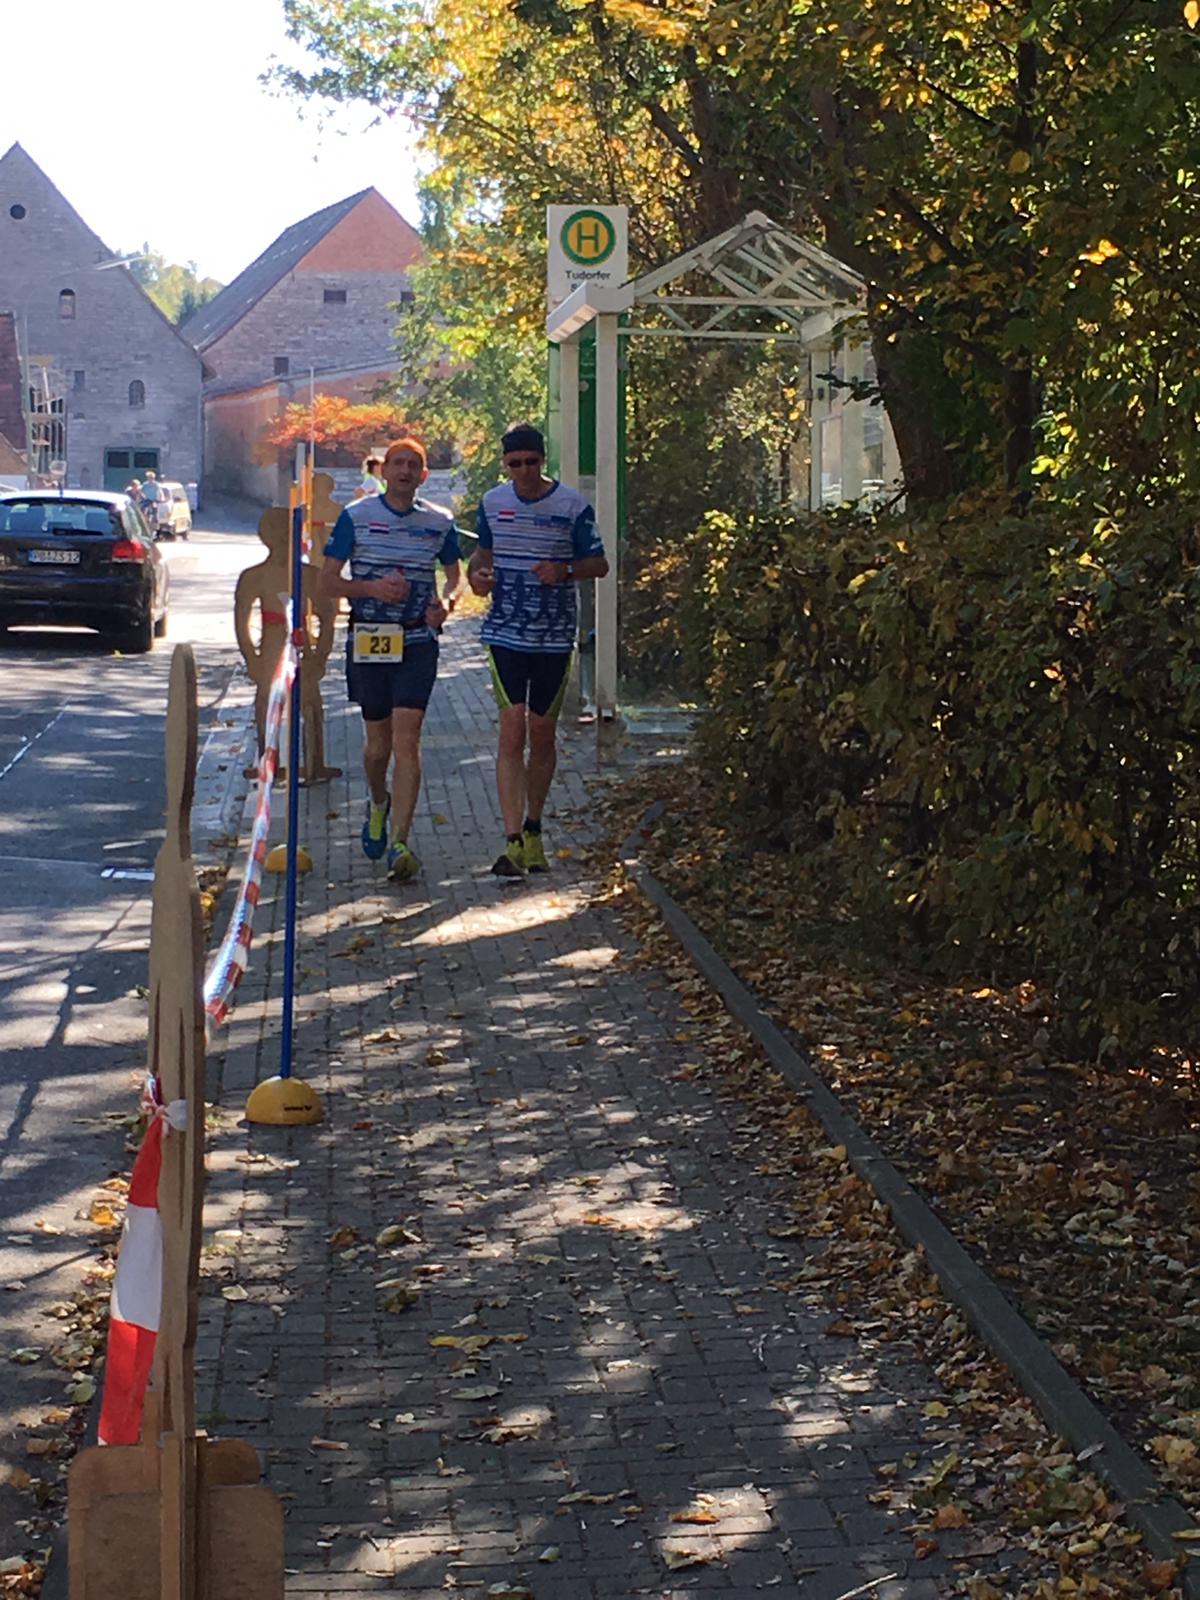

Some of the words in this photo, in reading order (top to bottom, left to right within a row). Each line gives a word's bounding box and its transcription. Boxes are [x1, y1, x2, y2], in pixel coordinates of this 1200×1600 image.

[577, 222, 599, 252] H
[565, 270, 611, 280] Tudorfer
[370, 636, 391, 654] 23
